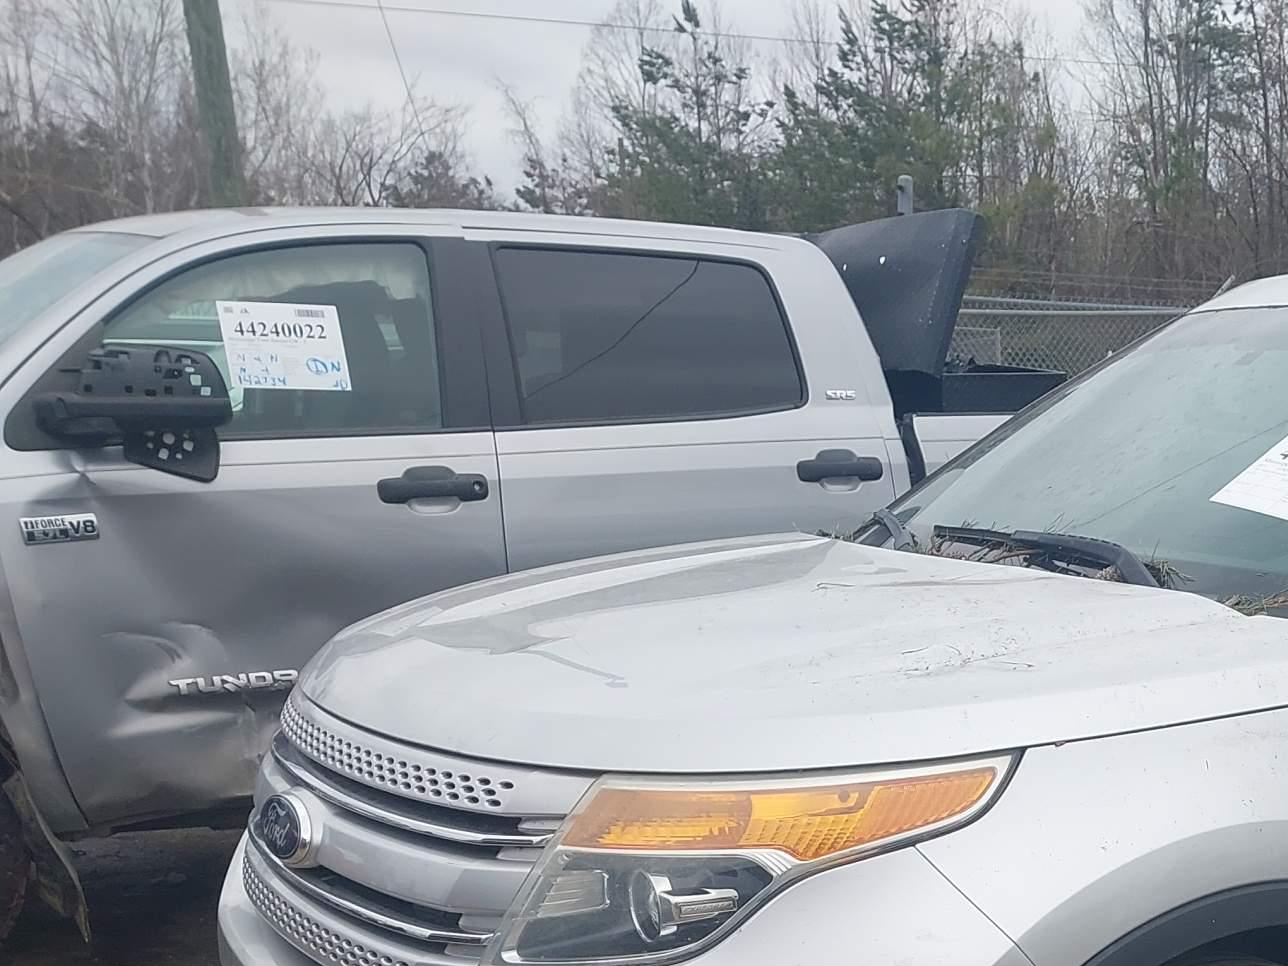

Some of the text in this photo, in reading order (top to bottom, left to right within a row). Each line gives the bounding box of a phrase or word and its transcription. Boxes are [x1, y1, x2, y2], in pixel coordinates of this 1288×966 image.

[234, 320, 327, 339] 44240022
[825, 390, 856, 400] SR5
[68, 519, 97, 536] V8
[168, 669, 299, 695] TUNDR
[263, 801, 291, 849] Ford
